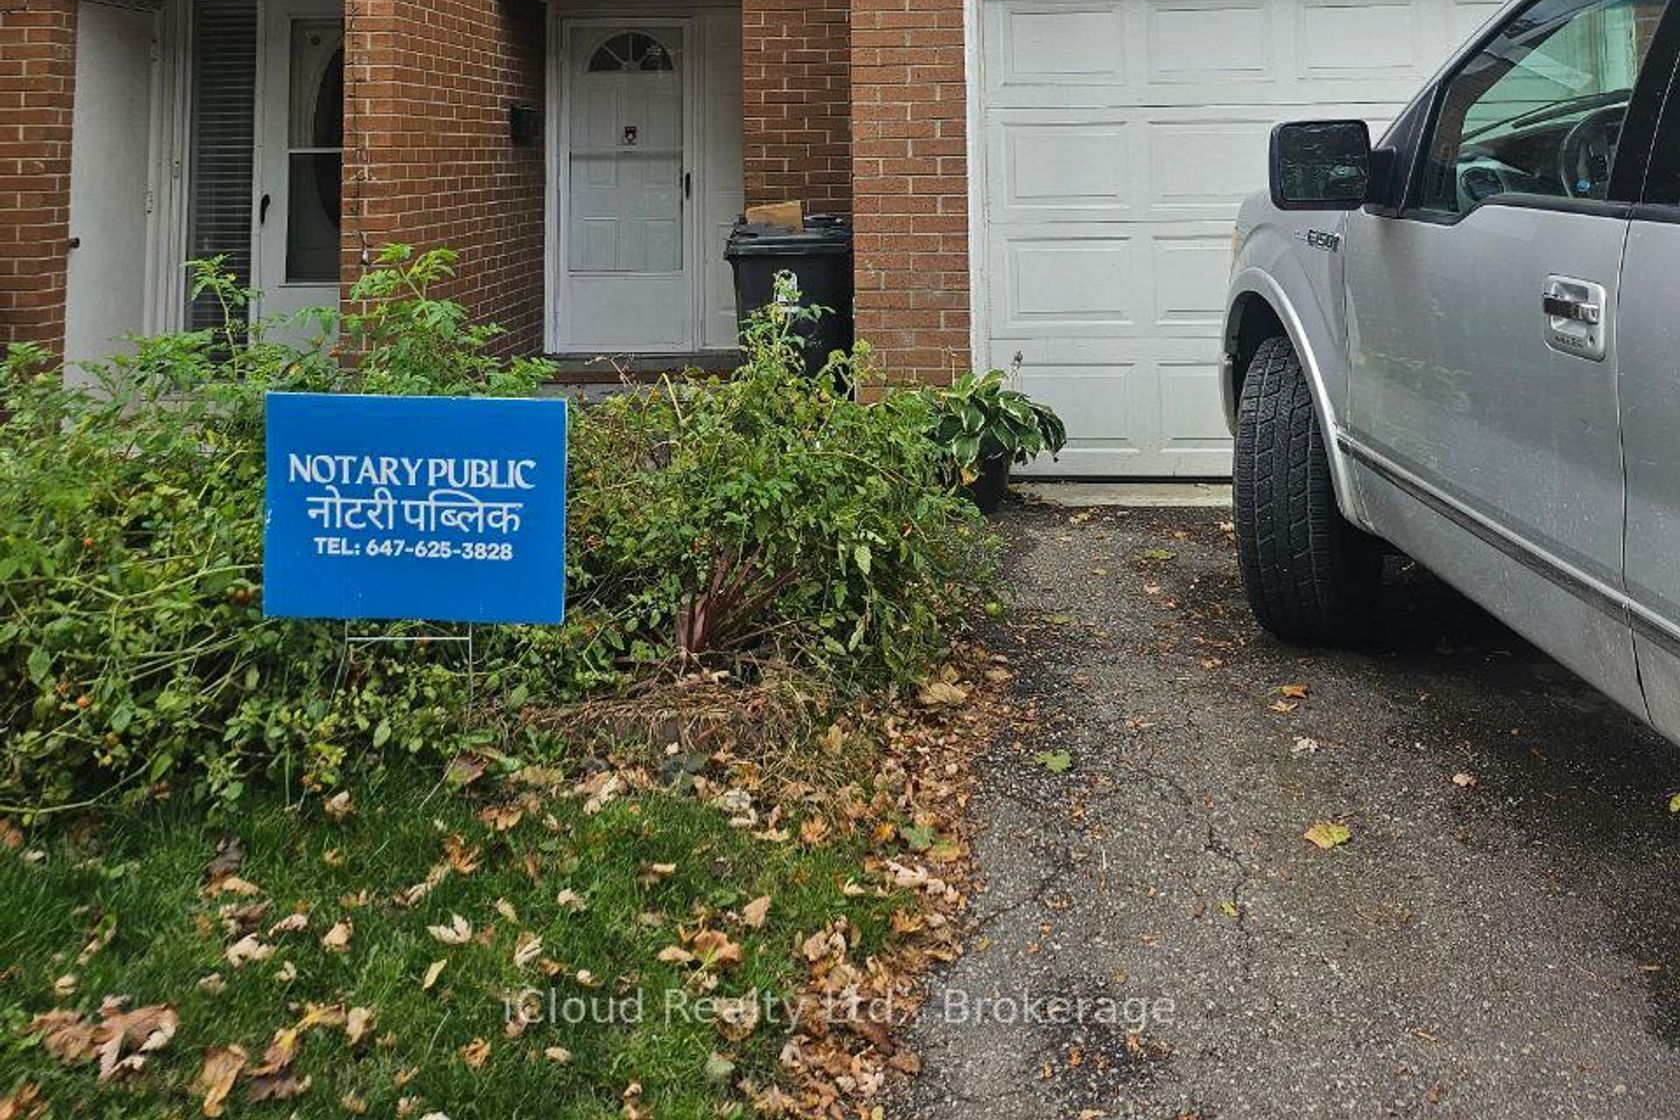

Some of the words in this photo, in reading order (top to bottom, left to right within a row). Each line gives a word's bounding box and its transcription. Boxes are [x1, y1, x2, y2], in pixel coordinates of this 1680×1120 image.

[289, 453, 423, 486] NOTARY
[427, 457, 537, 489] PUBLIC
[306, 485, 399, 530] नोटरी
[401, 488, 524, 534] पब्लिक
[313, 536, 360, 556] TEL:
[365, 538, 513, 561] 647-625-3828
